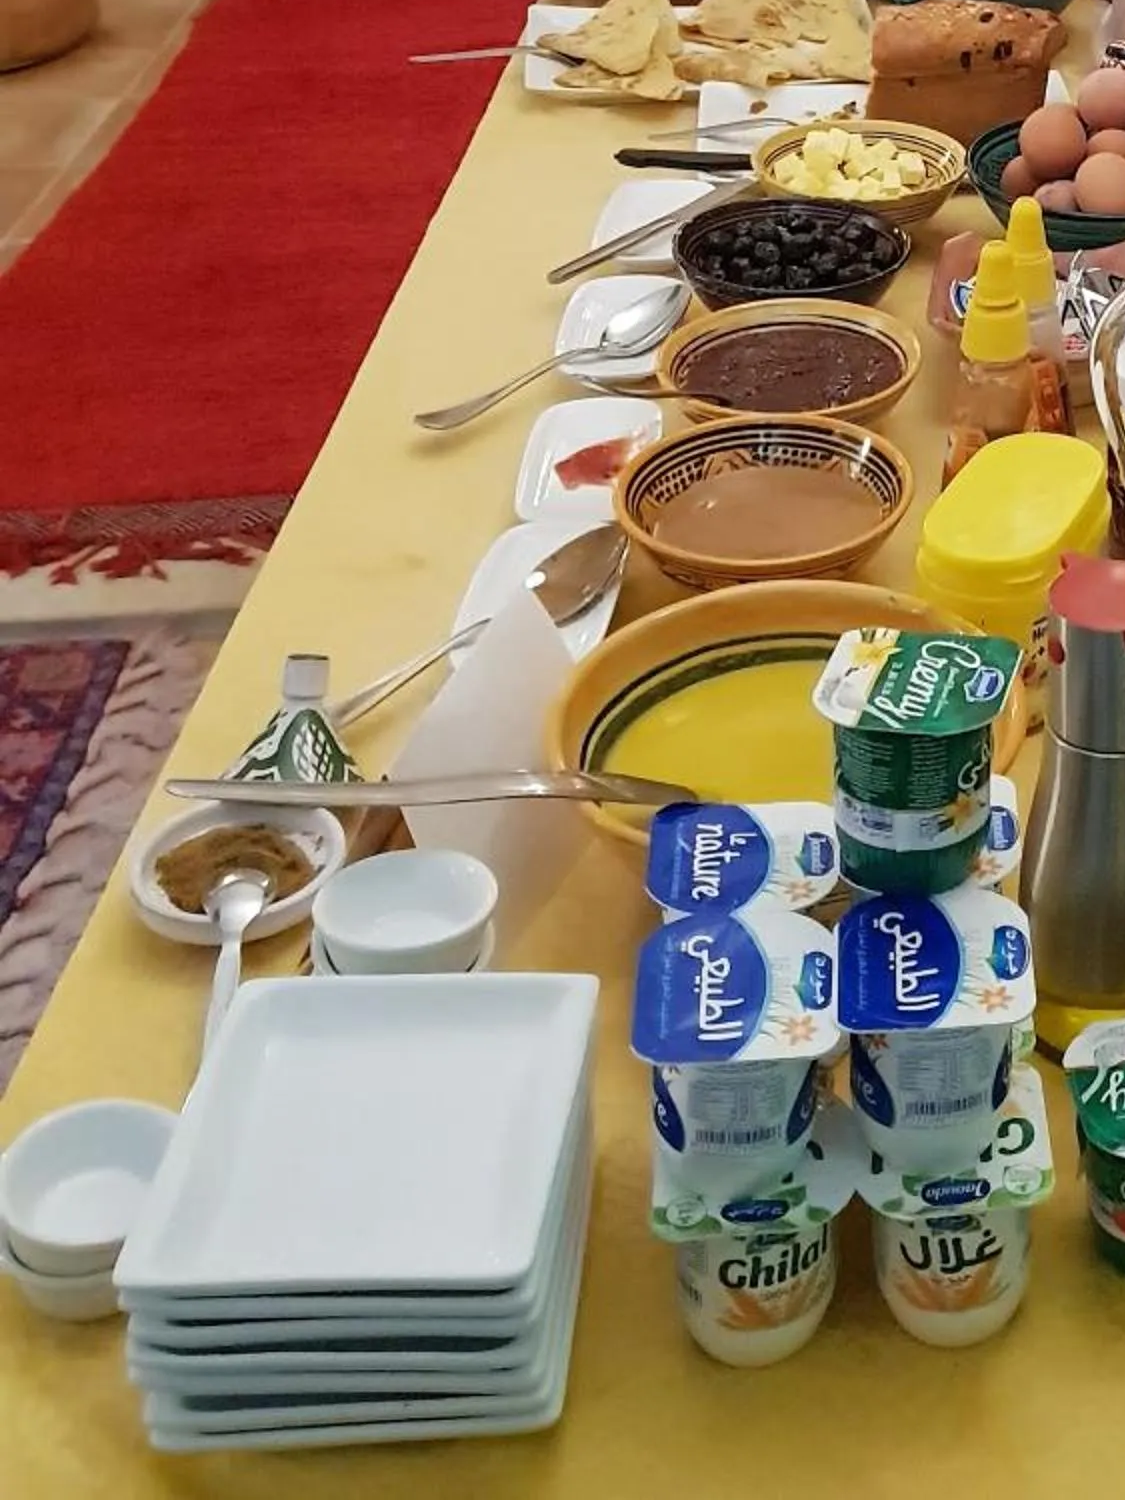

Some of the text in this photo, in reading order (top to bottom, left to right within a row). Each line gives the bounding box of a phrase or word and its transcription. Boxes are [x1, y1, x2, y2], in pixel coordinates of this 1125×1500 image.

[874, 640, 981, 720] Cremy
[692, 823, 739, 899] nature
[730, 832, 757, 846] le
[681, 935, 744, 1041] الطبيعي
[873, 912, 940, 1010] الطبيعي
[924, 1182, 984, 1201] Jaouda
[718, 1223, 828, 1289] Ghilal
[900, 1229, 1003, 1275] غلال
